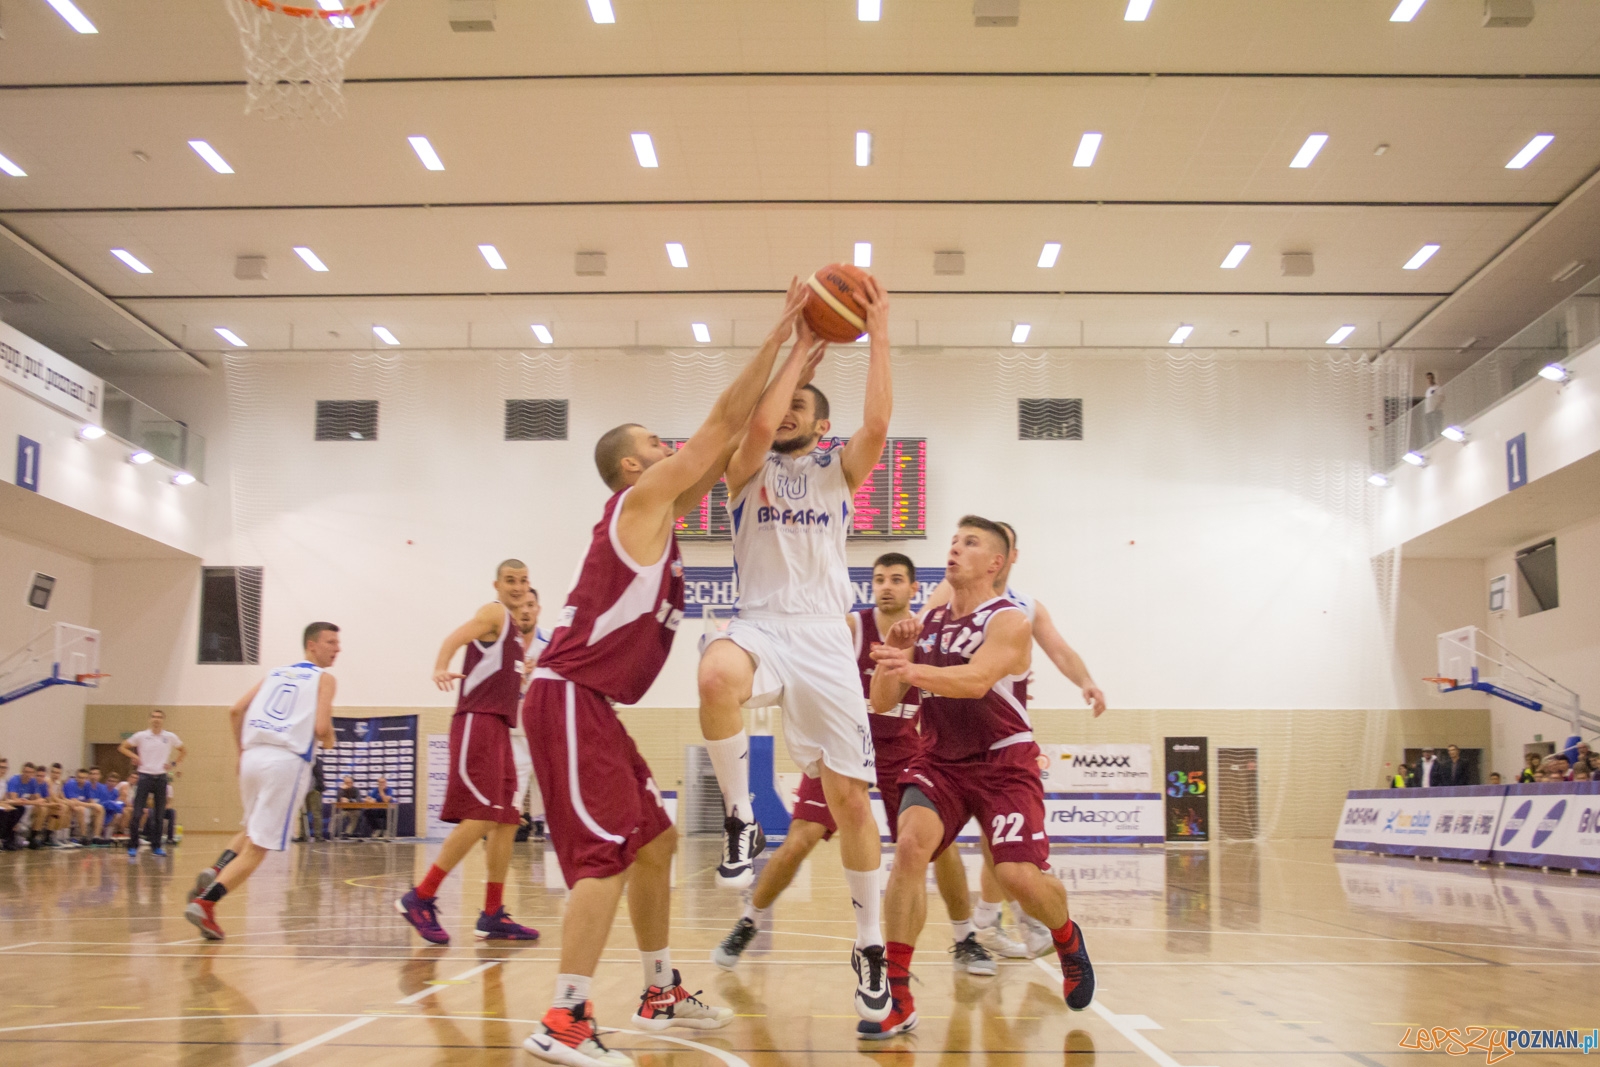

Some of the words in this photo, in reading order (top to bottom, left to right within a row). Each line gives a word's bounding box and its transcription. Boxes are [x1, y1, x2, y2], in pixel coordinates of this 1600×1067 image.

[23, 446, 35, 485] 1
[1510, 442, 1521, 483] 1
[949, 627, 983, 658] 22
[263, 683, 300, 721] 0
[1072, 755, 1131, 768] MAXXX
[1167, 770, 1207, 798] 35
[991, 812, 1025, 846] 22
[1050, 805, 1142, 827] rehasport
